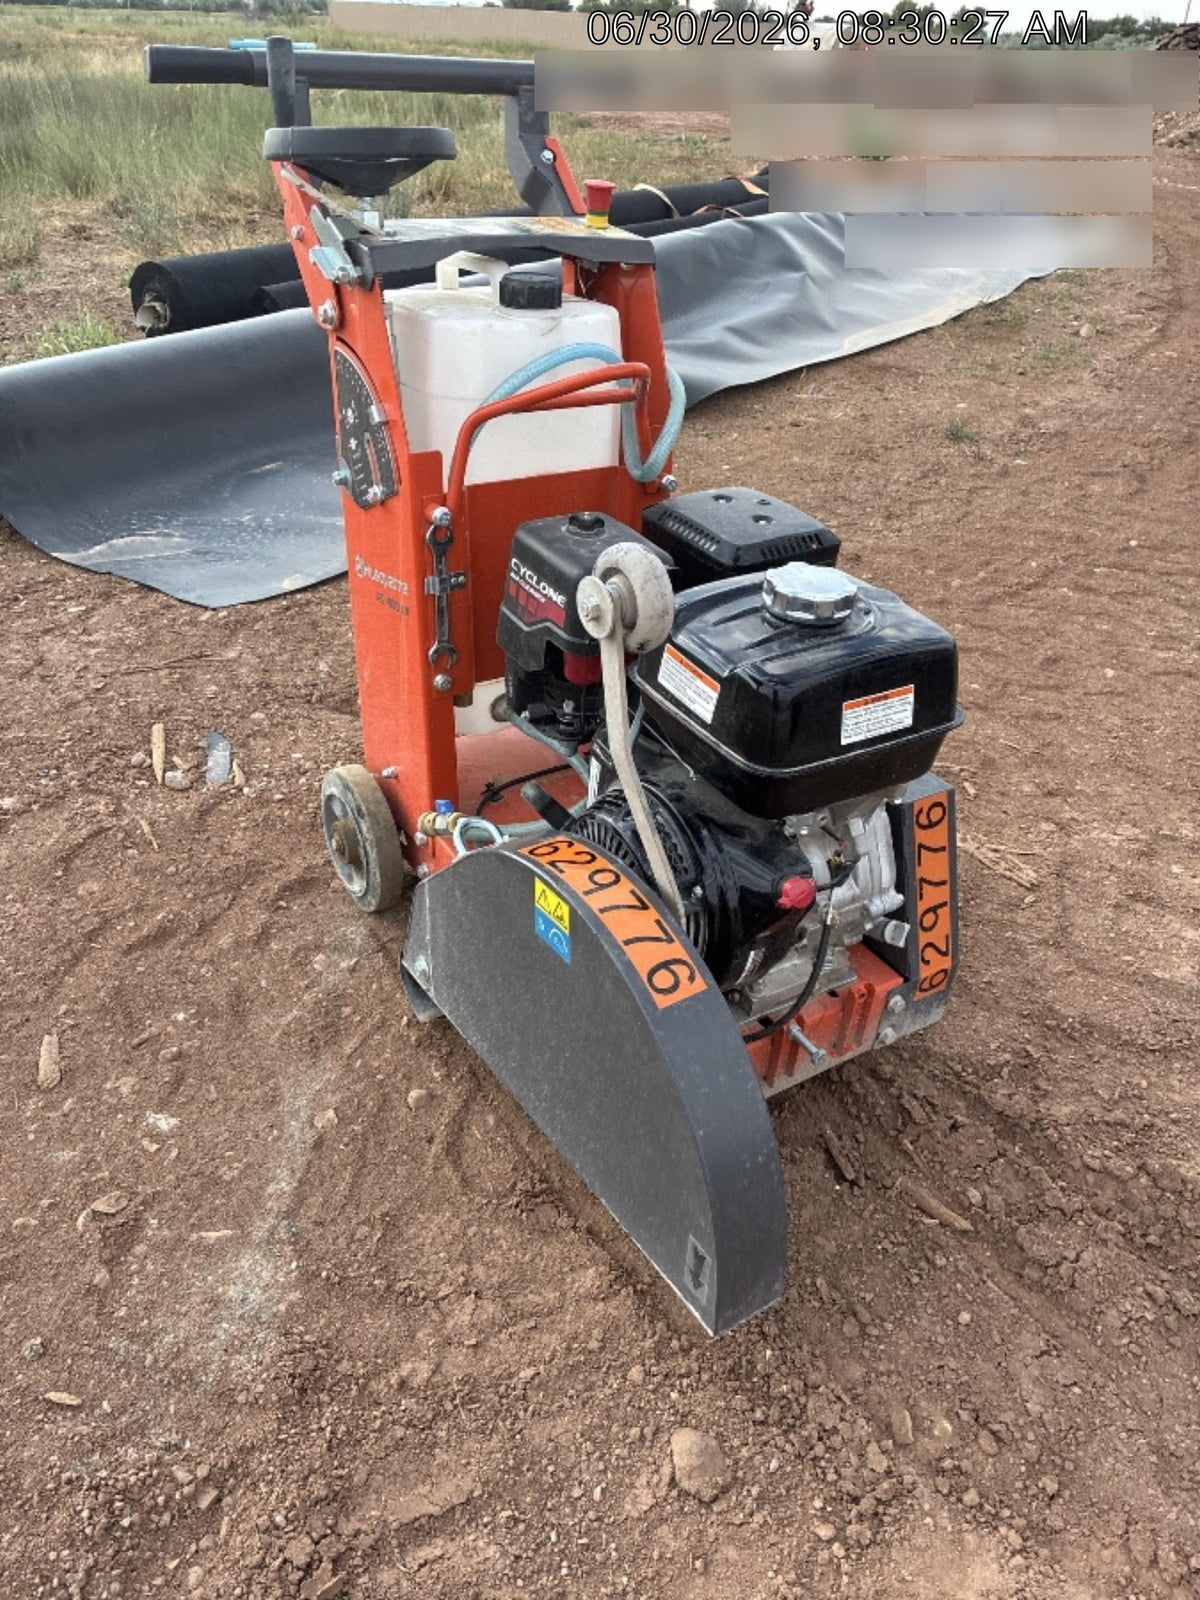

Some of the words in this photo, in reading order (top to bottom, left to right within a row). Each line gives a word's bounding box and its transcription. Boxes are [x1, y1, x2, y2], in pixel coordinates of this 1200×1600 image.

[511, 557, 568, 609] CYCLONE
[527, 839, 696, 996] 629776
[915, 800, 951, 993] 629776
